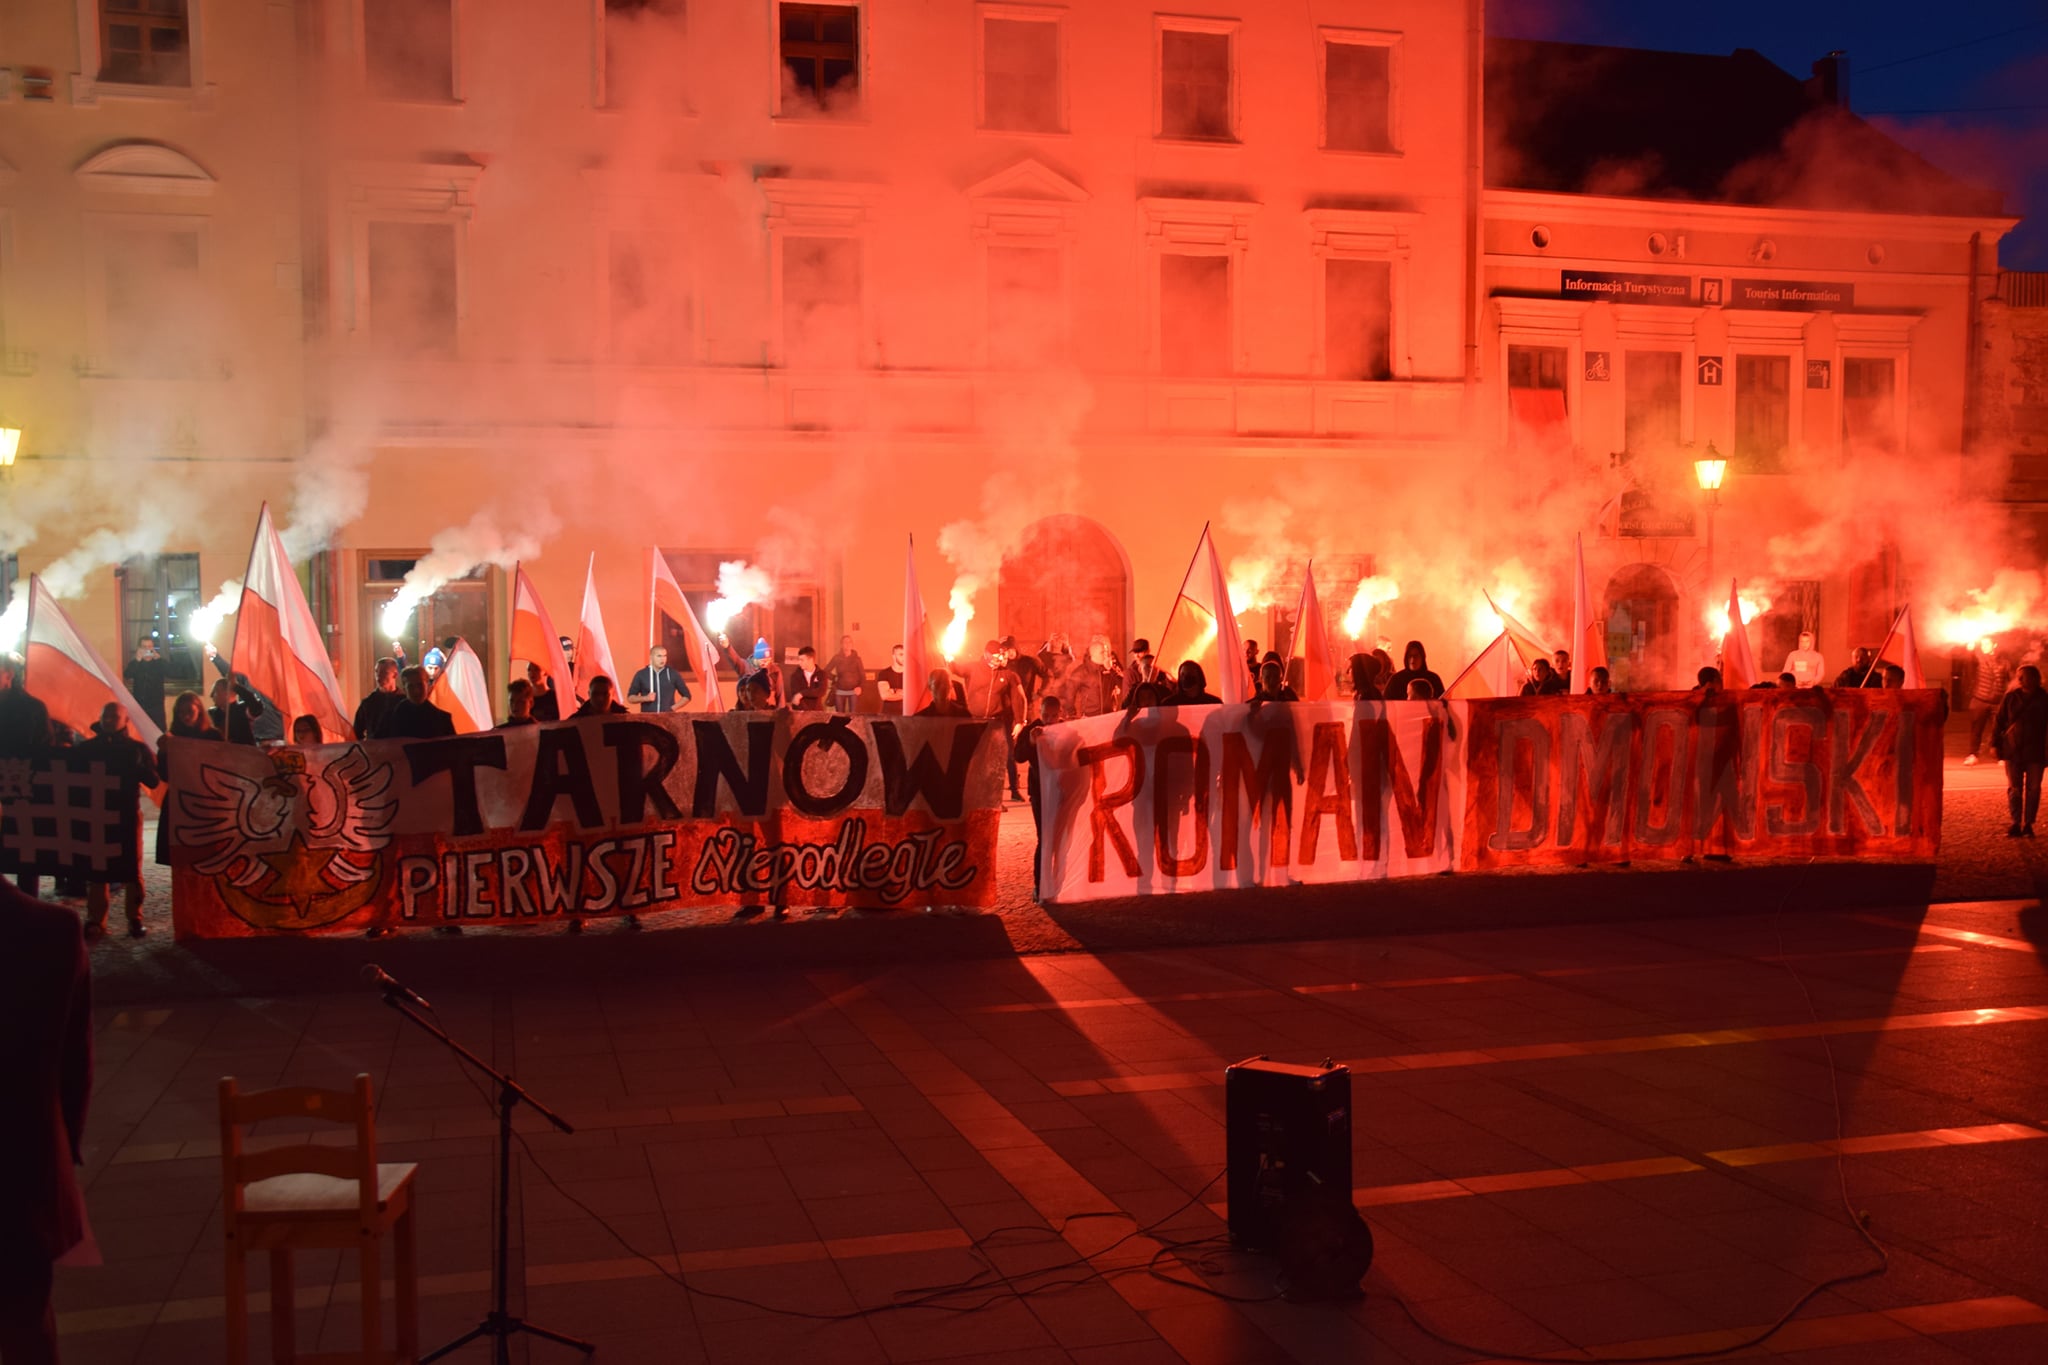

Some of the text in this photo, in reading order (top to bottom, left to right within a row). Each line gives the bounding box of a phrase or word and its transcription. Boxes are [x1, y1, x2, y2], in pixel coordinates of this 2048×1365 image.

[1565, 279, 1686, 296] Informacja Turystyczna
[1745, 287, 1841, 302] Tourist Information
[403, 715, 989, 836] TARNÓW
[1077, 705, 1916, 884] ROMAN DMOWSKI
[401, 830, 679, 920] PIERWSZE
